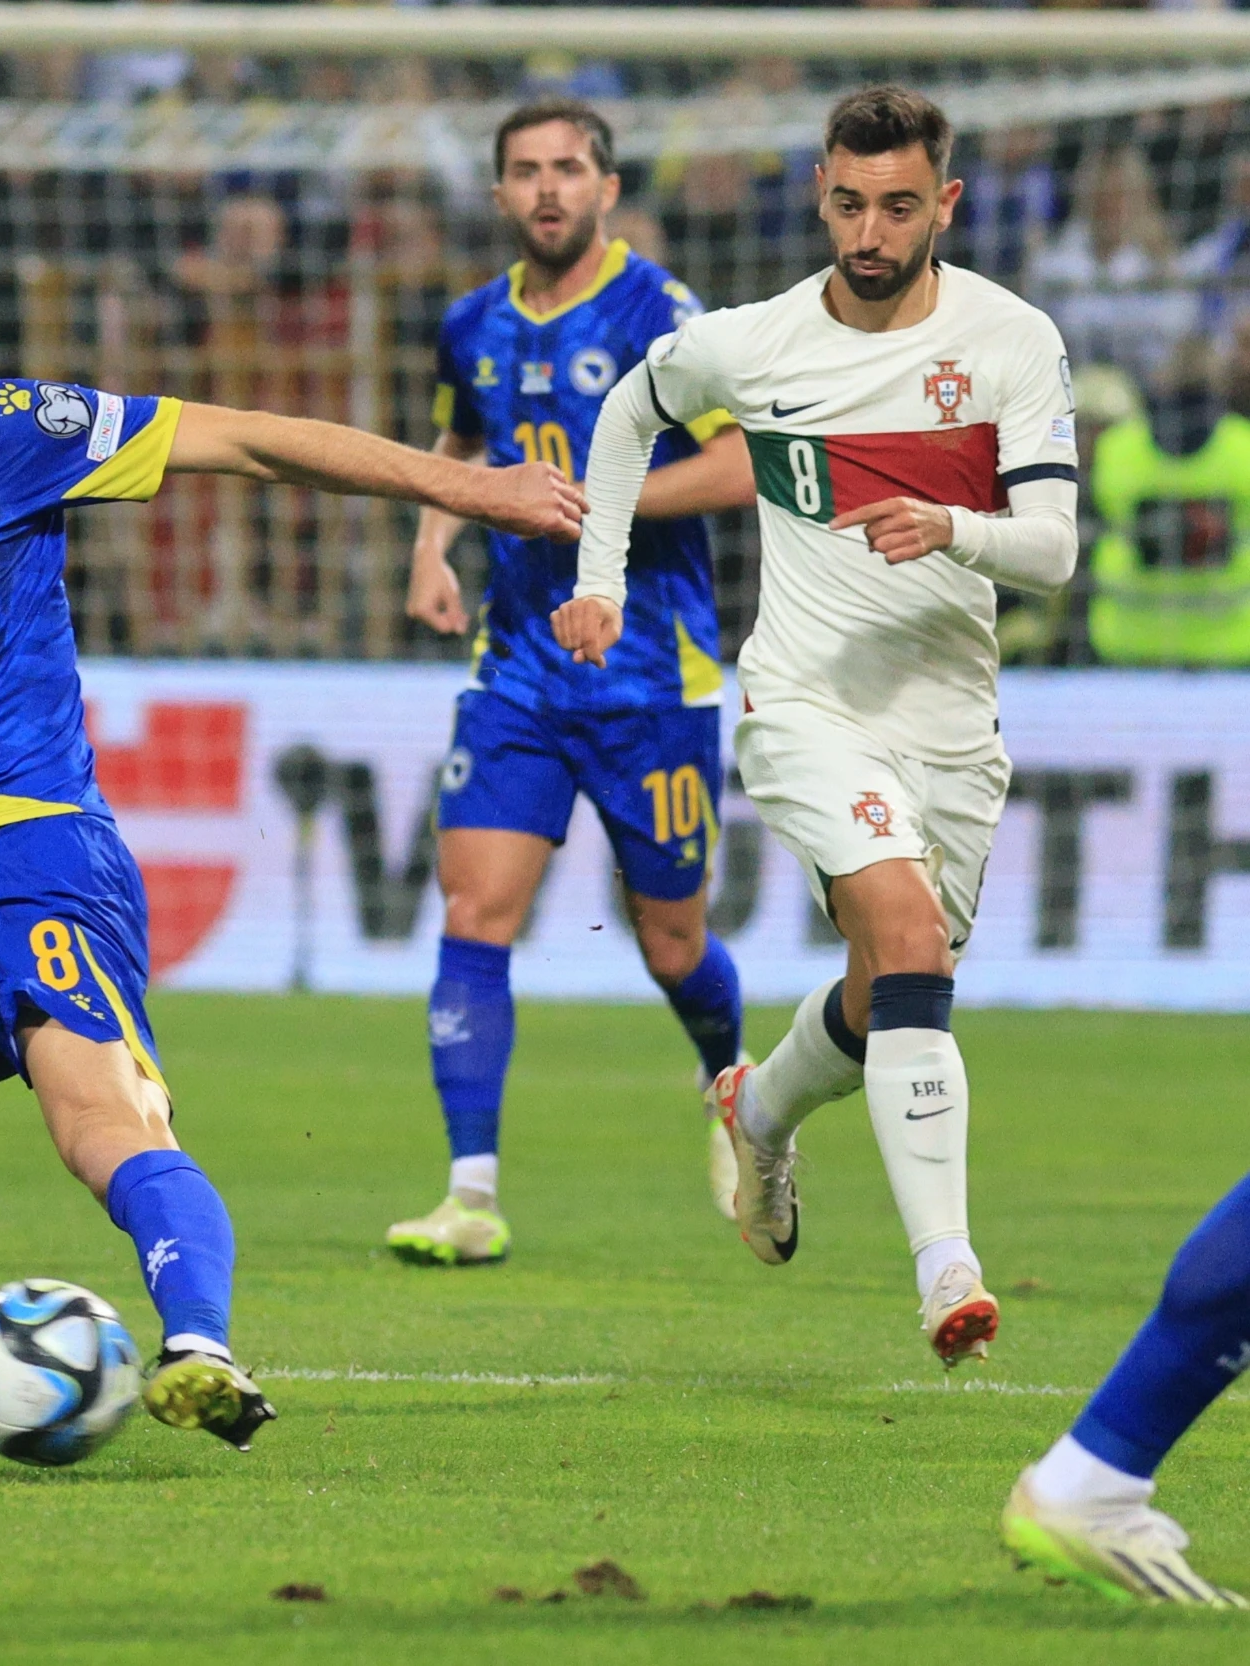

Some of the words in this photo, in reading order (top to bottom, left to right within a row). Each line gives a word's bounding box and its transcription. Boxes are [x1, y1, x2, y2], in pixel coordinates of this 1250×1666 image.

[513, 421, 574, 486] 10
[788, 440, 821, 515] 8
[641, 764, 700, 844] 10
[29, 919, 81, 992] 8
